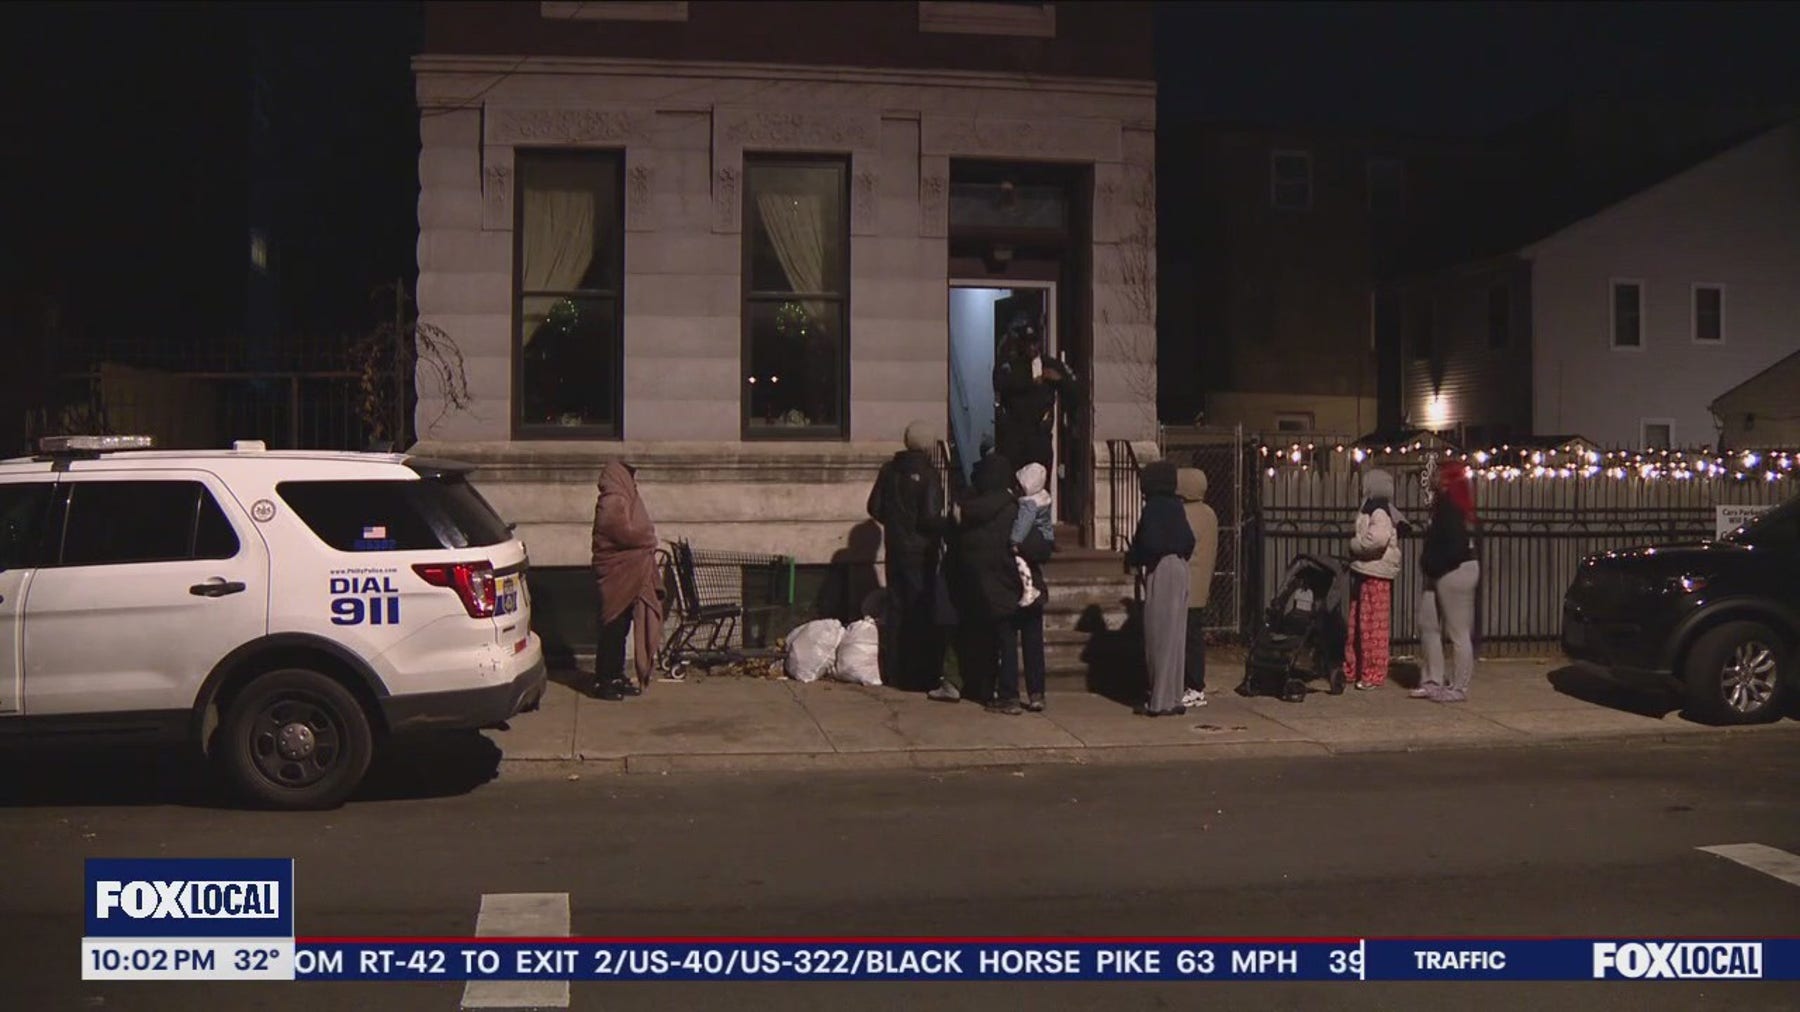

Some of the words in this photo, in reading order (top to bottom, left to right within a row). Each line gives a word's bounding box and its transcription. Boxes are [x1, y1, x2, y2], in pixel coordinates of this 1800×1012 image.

[1722, 508, 1738, 516] Cars
[330, 576, 399, 594] DIAL
[330, 596, 399, 625] 911
